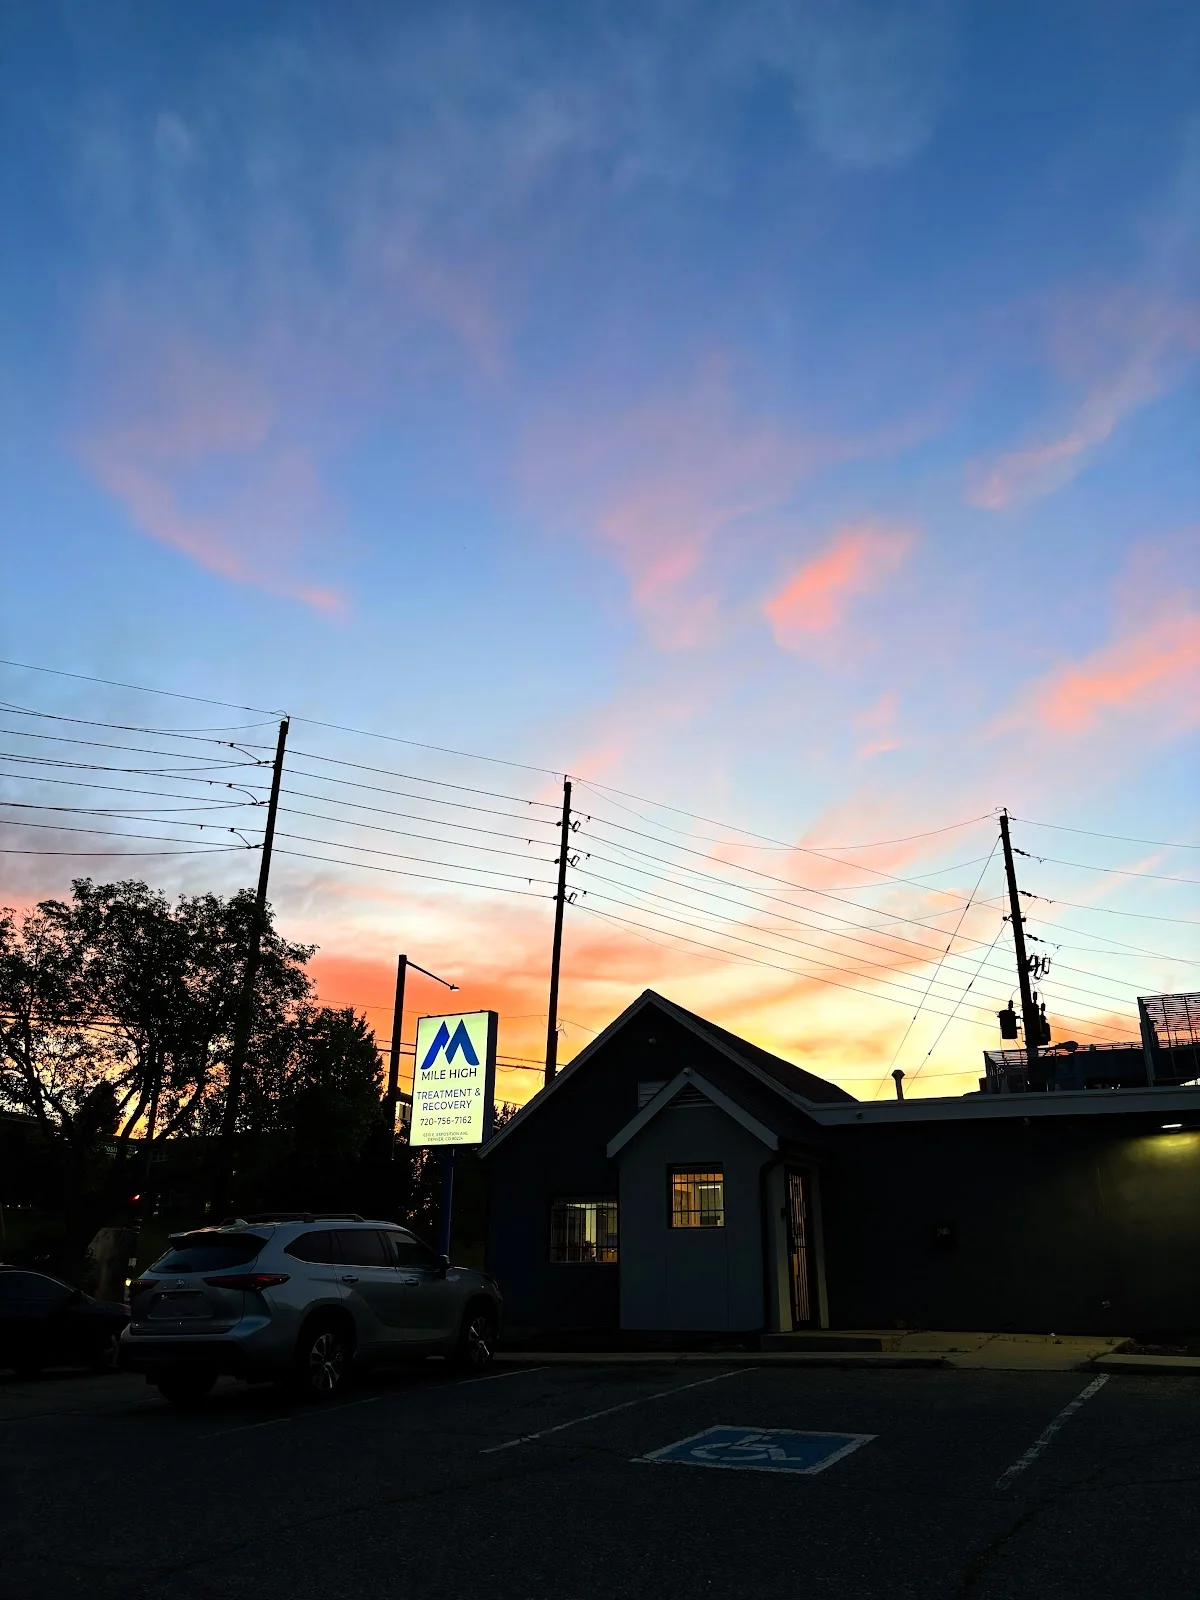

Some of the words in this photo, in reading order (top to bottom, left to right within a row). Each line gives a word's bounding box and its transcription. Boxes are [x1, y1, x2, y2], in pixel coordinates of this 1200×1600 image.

[422, 1070, 446, 1081] MILE
[449, 1068, 477, 1079] HIGH
[417, 1088, 472, 1100] TREATMENT
[474, 1088, 480, 1096] &
[422, 1100, 472, 1111] RECOVERY
[420, 1116, 472, 1126] 720-756-7162
